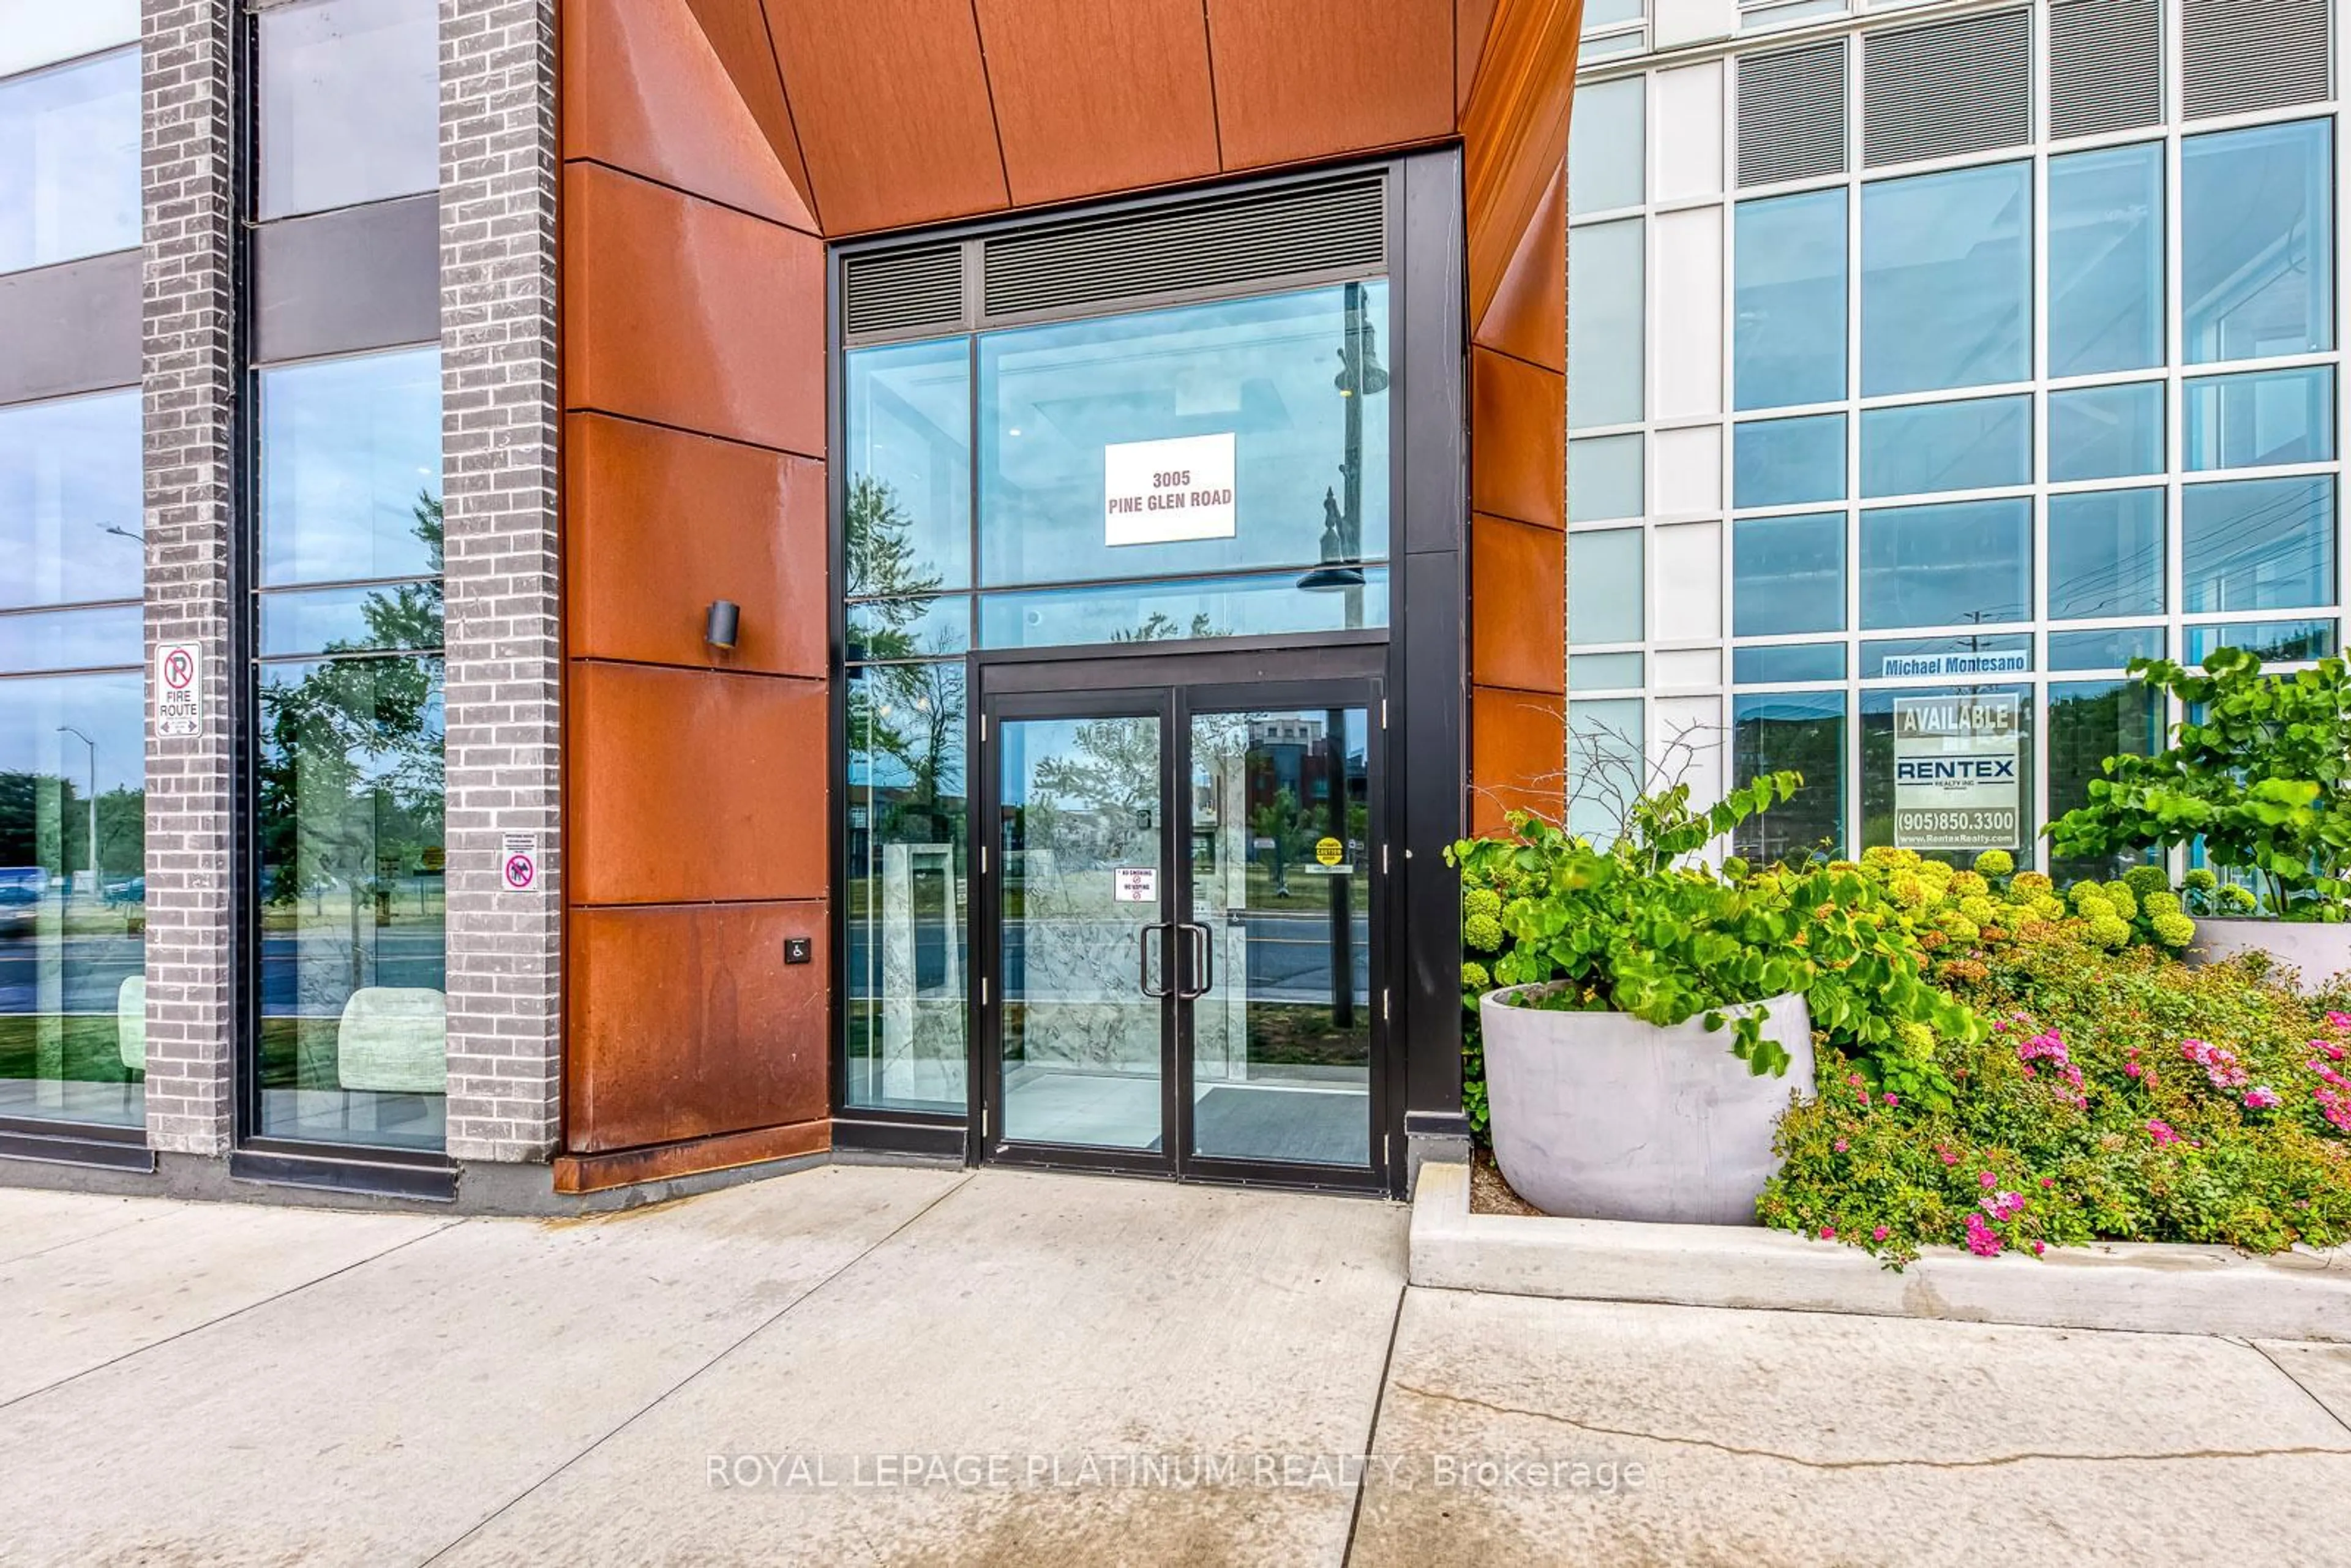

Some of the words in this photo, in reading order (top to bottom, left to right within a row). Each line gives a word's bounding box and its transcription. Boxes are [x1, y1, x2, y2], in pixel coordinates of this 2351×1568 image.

[1153, 470, 1190, 488] 3005
[1109, 497, 1142, 514] PINE
[1147, 493, 1185, 511] GLEN
[1191, 489, 1231, 506] ROAD
[1886, 658, 1940, 675] Michael
[1946, 656, 2024, 672] Montesano
[167, 691, 190, 703] FIRE
[160, 703, 197, 716] ROUTE
[1904, 704, 2009, 731] AVAILABLE
[1898, 760, 2014, 779] RENTEX
[1899, 812, 2014, 831] (905)850.3300
[1900, 835, 2013, 844] www.RentexRealty.com
